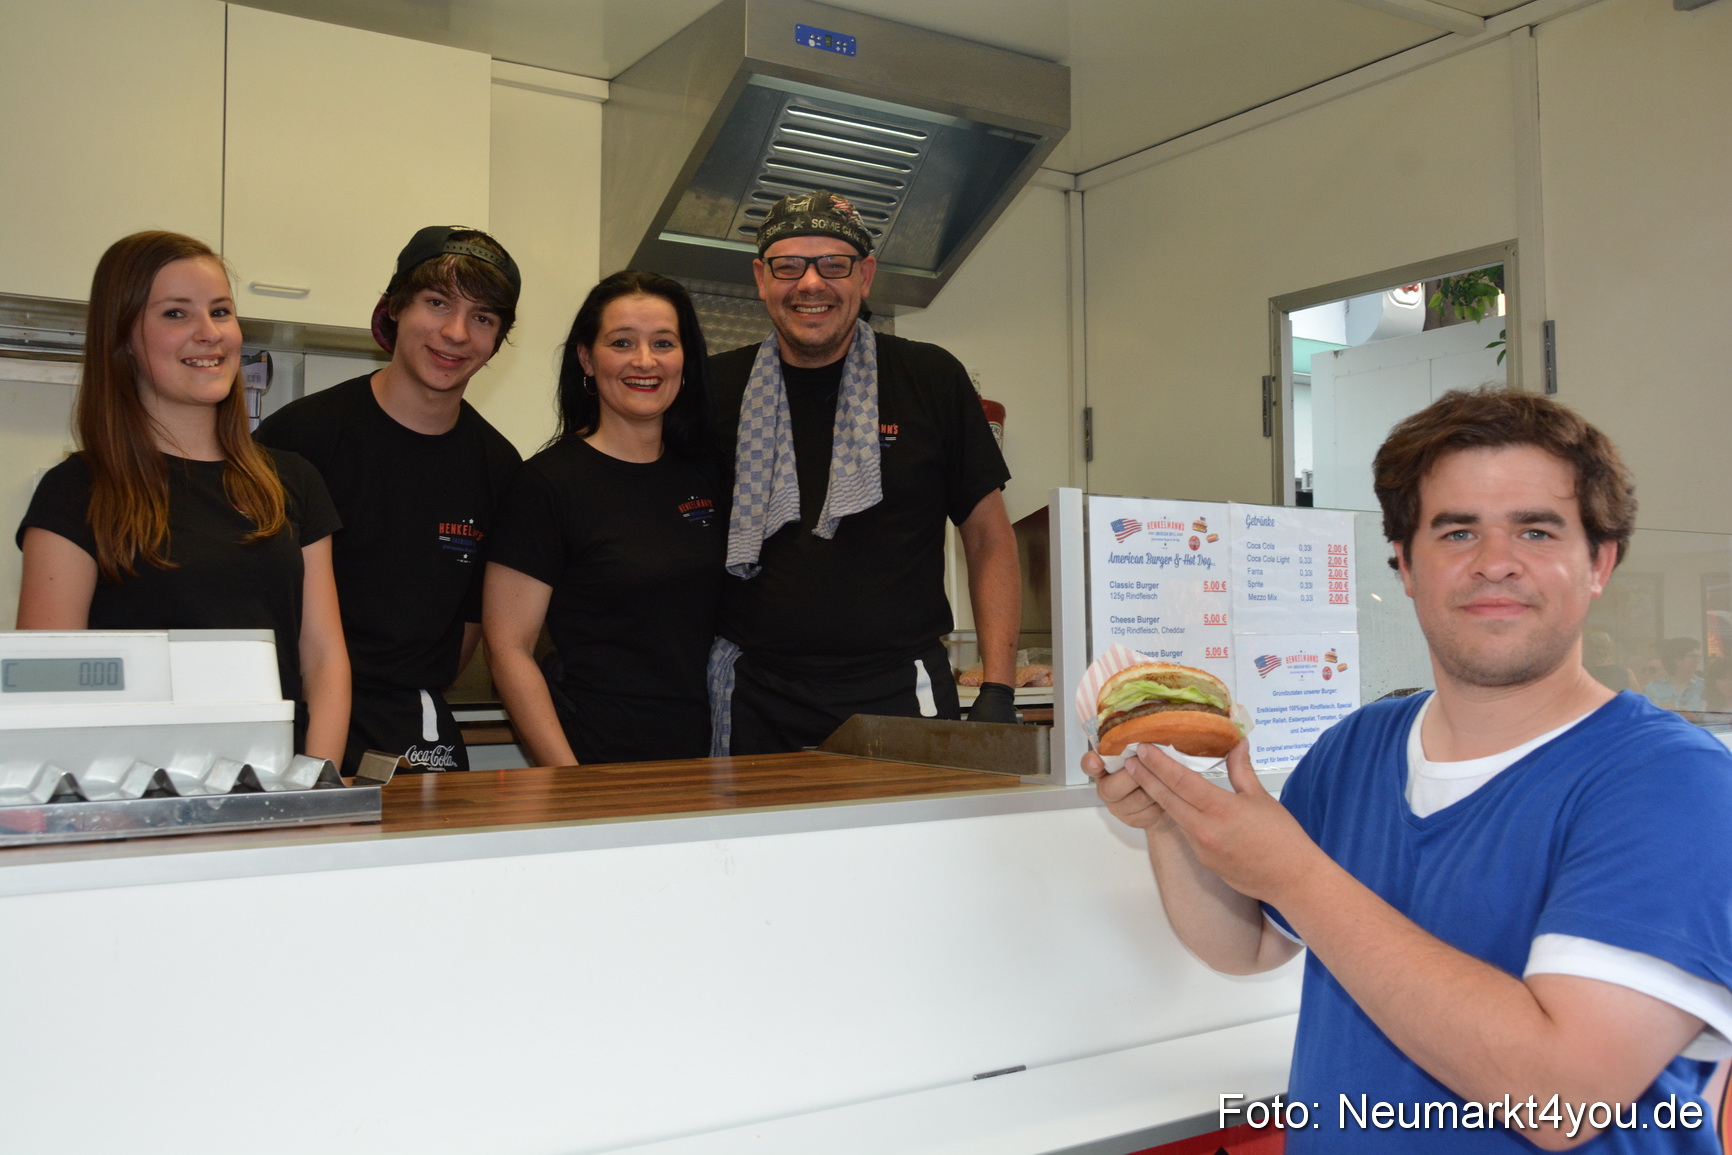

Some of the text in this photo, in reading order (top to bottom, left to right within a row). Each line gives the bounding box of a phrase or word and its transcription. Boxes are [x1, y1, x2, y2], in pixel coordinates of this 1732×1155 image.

[812, 218, 841, 232] SOME
[1246, 514, 1275, 530] Getränke
[1246, 542, 1261, 550] Coca
[1343, 544, 1348, 553] €
[1108, 552, 1144, 564] American
[1146, 552, 1172, 569] Burger
[1182, 554, 1196, 566] Hot
[1246, 554, 1261, 562] Coca
[1262, 555, 1276, 563] Cola
[1276, 556, 1290, 564] Light
[1344, 557, 1348, 566] €
[1247, 568, 1263, 576] Fanta
[1344, 569, 1348, 578] €
[1110, 581, 1134, 589] Classic
[1136, 582, 1159, 590] Burger
[1222, 581, 1226, 590] €
[1248, 580, 1264, 588] Sprite
[1344, 582, 1348, 590] €
[1110, 592, 1158, 601] 125g Rindfleisch
[1344, 594, 1349, 602] €
[1137, 616, 1160, 625] Burger
[1222, 614, 1227, 623] €
[1110, 627, 1125, 636] 125g
[1126, 626, 1160, 634] Rindfleisch,
[1160, 650, 1183, 658] Burger
[1224, 647, 1228, 656] €
